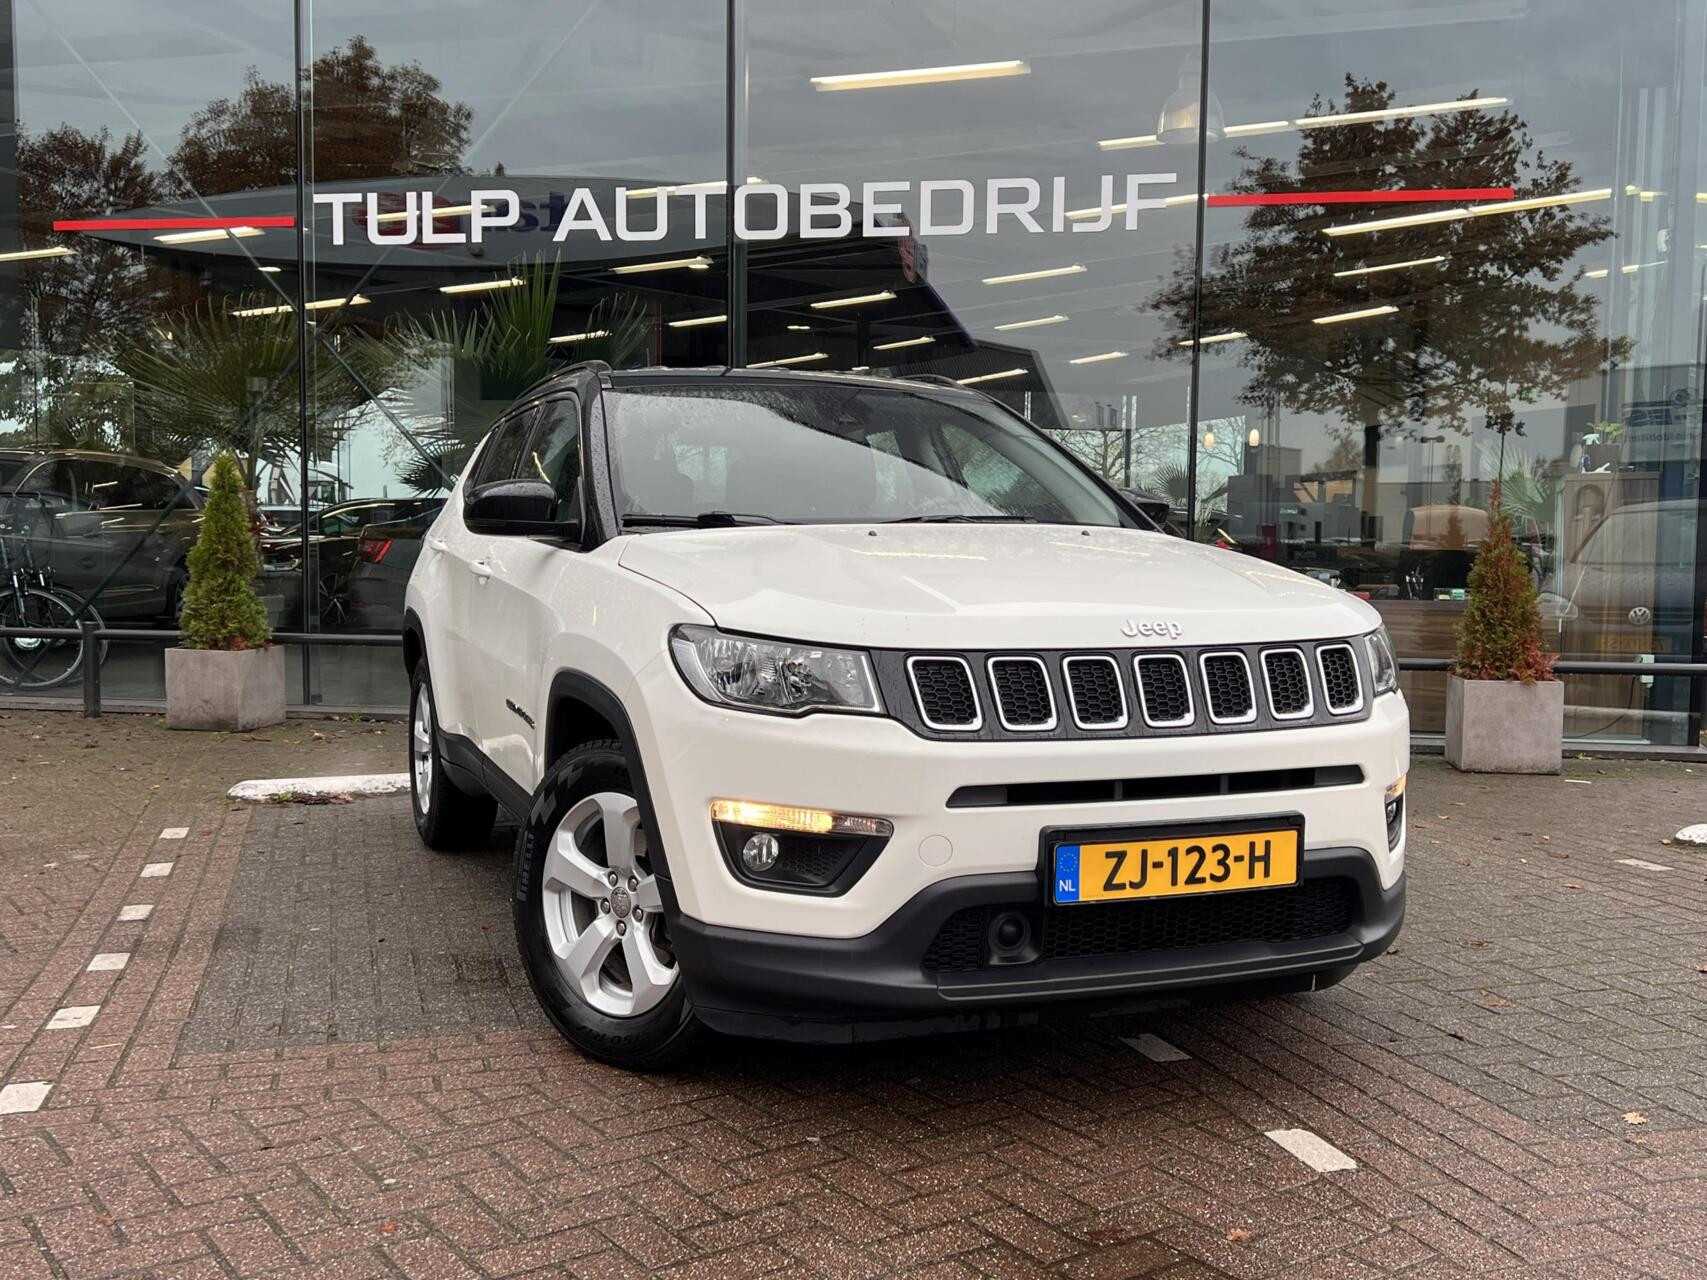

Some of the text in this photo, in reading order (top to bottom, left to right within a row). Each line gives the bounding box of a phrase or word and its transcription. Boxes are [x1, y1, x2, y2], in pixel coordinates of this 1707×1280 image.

[313, 189, 520, 245] TULP
[552, 172, 1178, 242] AUTOBEDRIJF
[1121, 618, 1182, 640] Jeep
[1103, 840, 1271, 891] ZJ-123-H
[1059, 879, 1076, 892] NL
